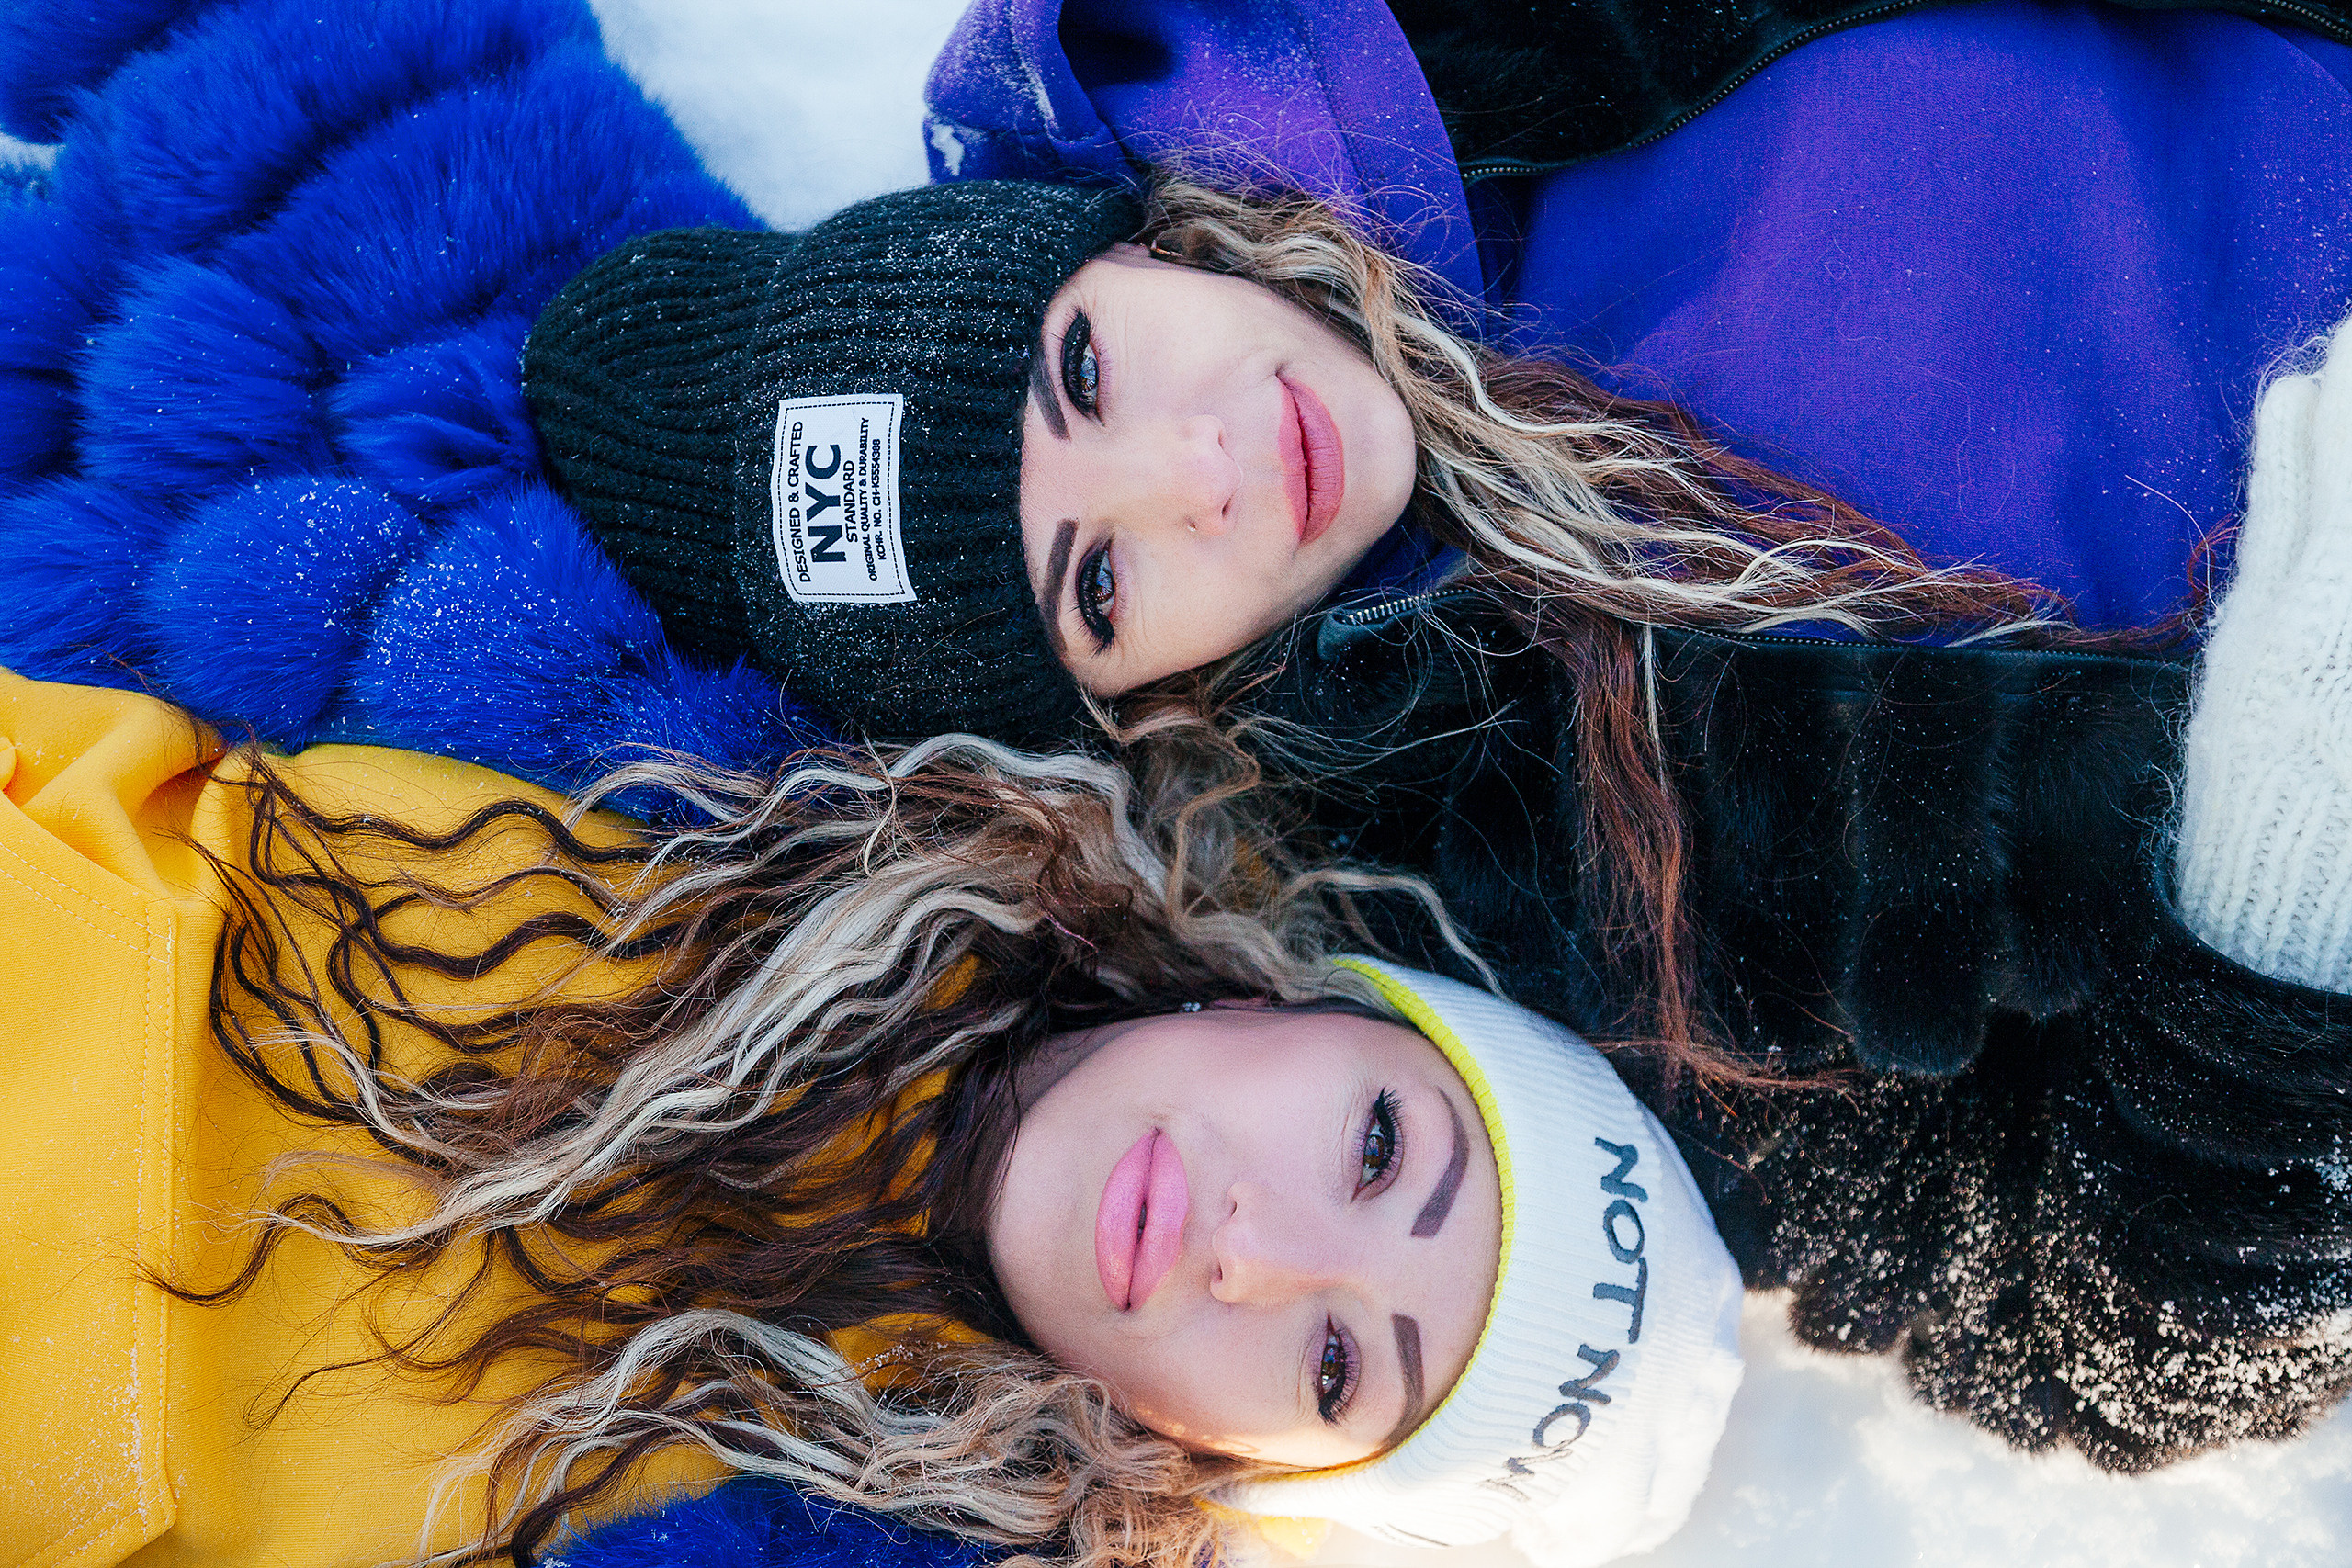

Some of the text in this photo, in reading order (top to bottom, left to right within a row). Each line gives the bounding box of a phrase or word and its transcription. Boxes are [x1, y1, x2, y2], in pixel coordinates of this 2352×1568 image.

[787, 421, 811, 582] DESIGNED & CRAFTED
[805, 444, 847, 563] NYC
[842, 460, 858, 543] STANDARD
[858, 418, 878, 581] ORIGINAL QUALITY & DURABILITY
[873, 509, 882, 526] NO.
[1476, 1136, 1649, 1502] NOT NOW
